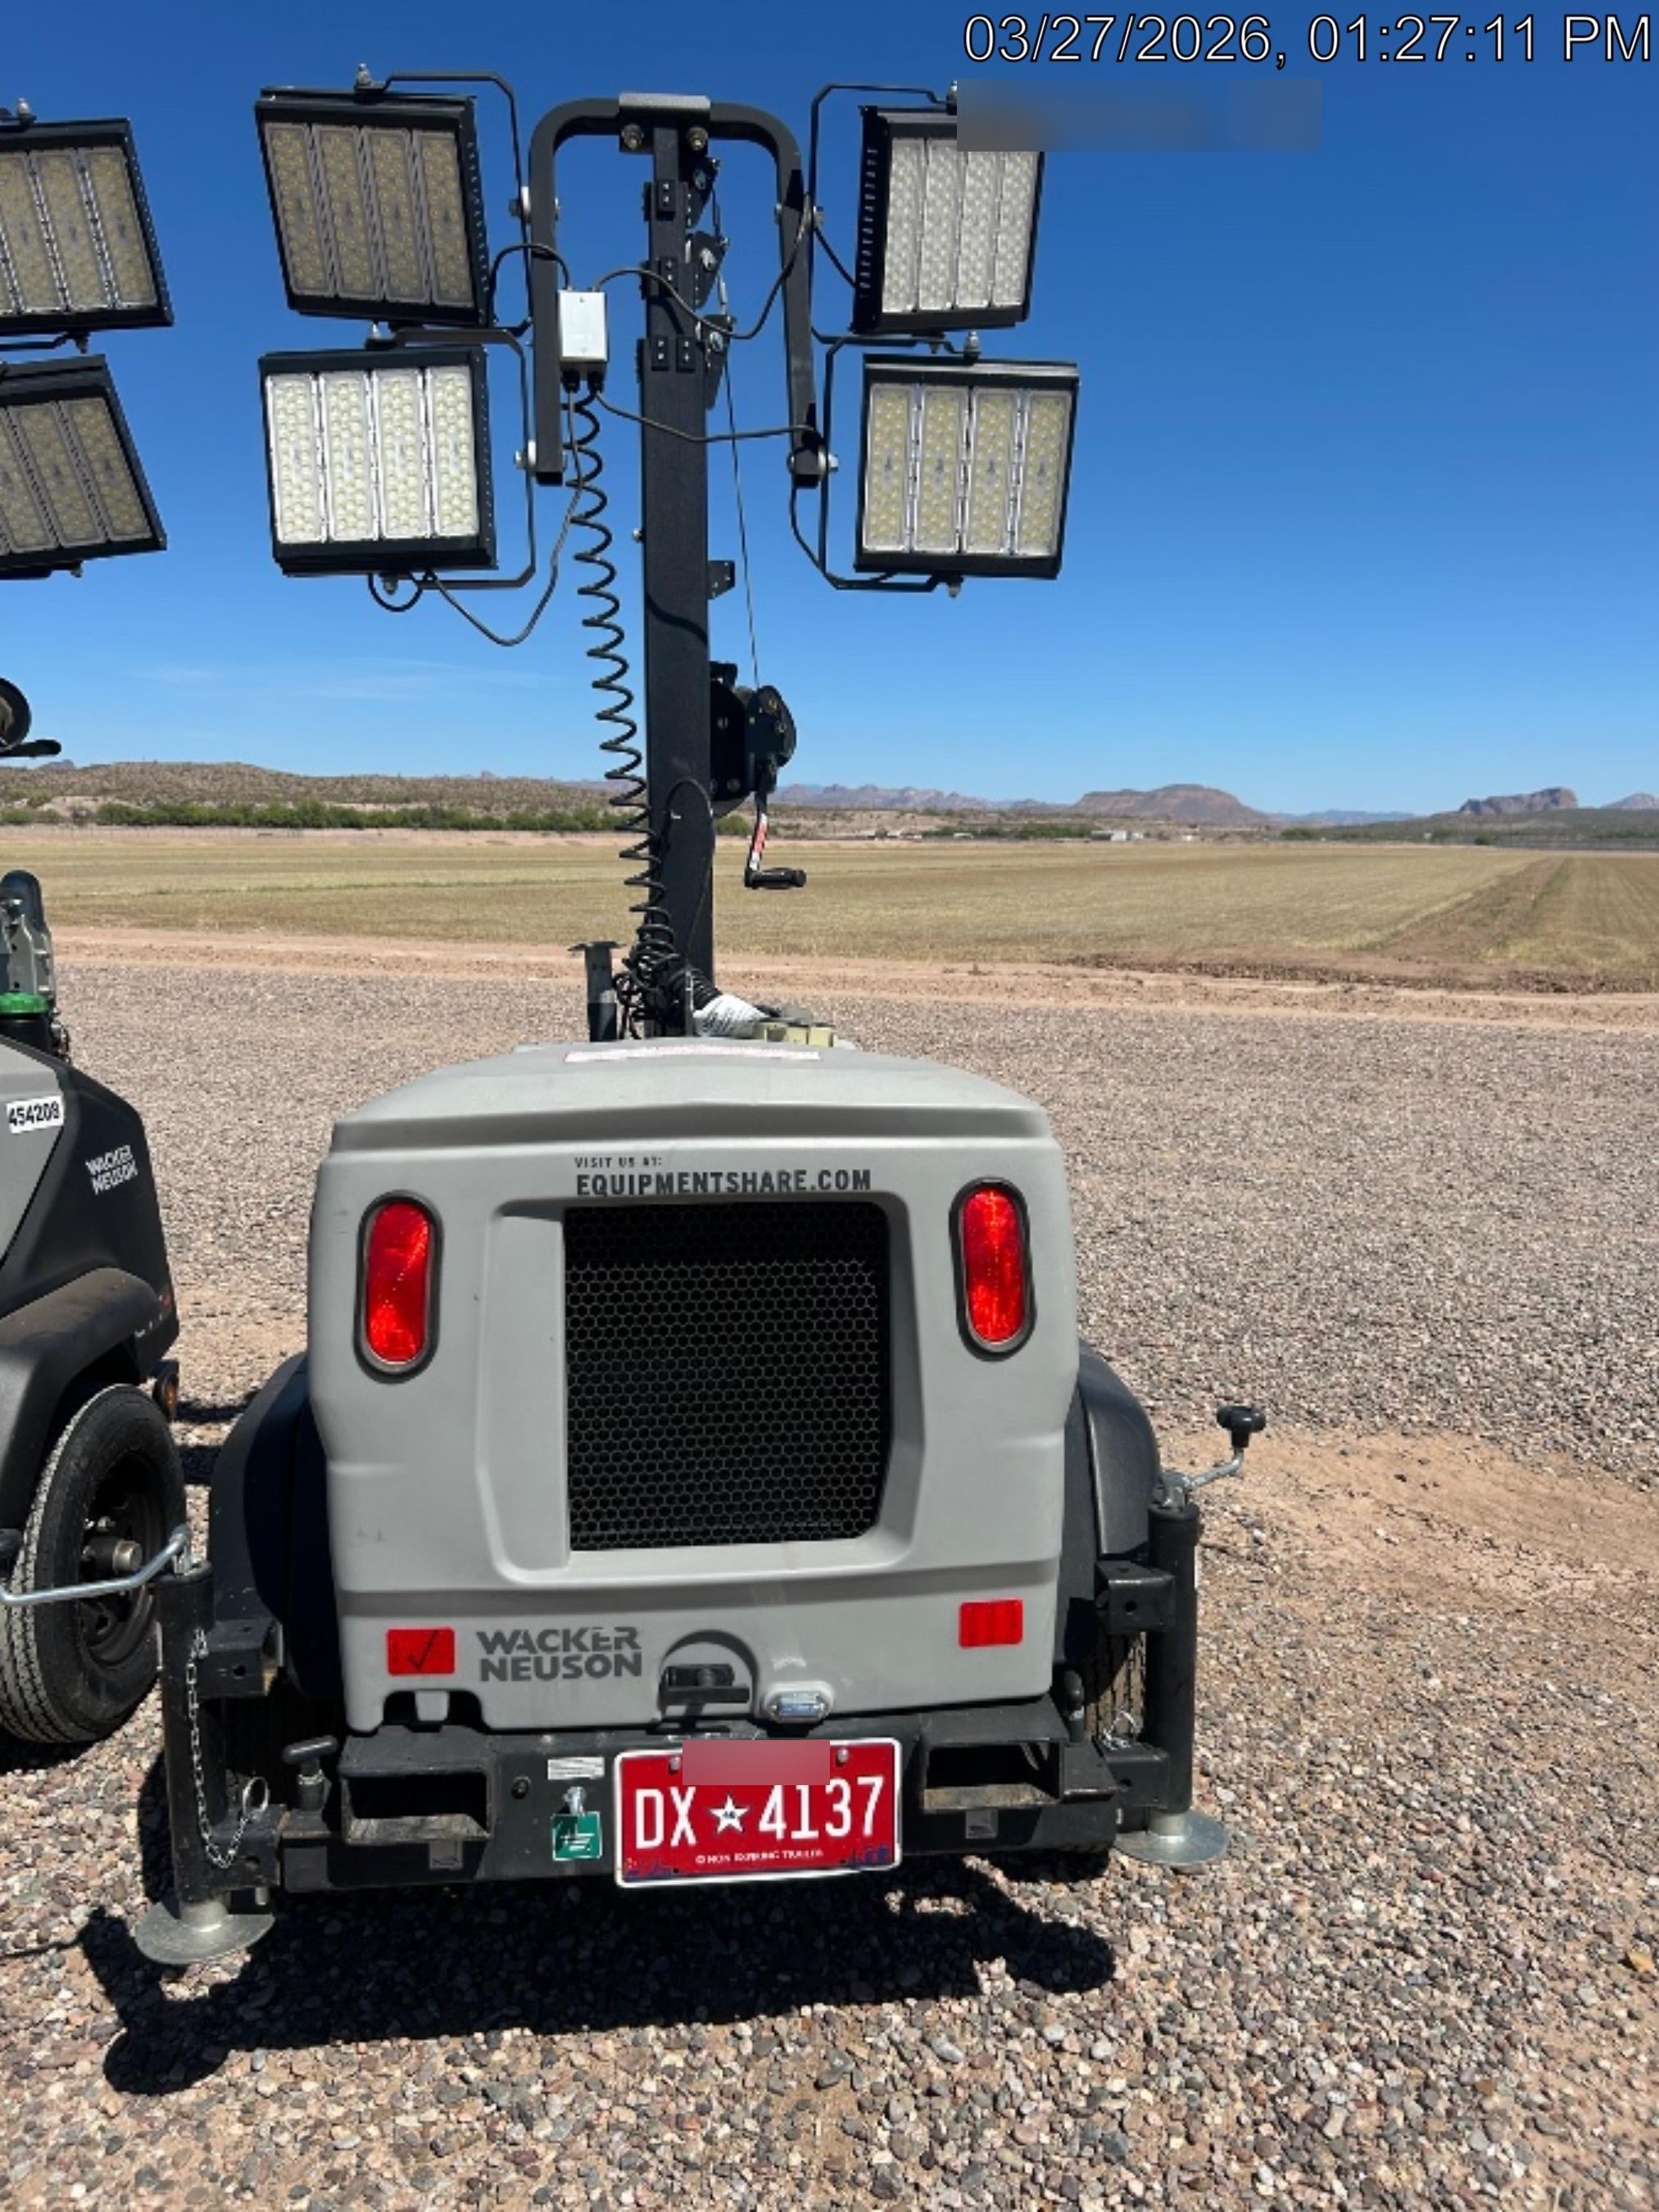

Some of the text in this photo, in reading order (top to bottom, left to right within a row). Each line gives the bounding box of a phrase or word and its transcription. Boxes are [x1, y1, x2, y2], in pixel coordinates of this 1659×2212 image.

[574, 1156, 663, 1168] VISIT US AT:
[576, 1169, 872, 1197] EQUIPMENTSHARE.COM
[476, 1626, 642, 1655] WACKER
[480, 1652, 642, 1681] NEUSON
[635, 1775, 885, 1849] DX 4137
